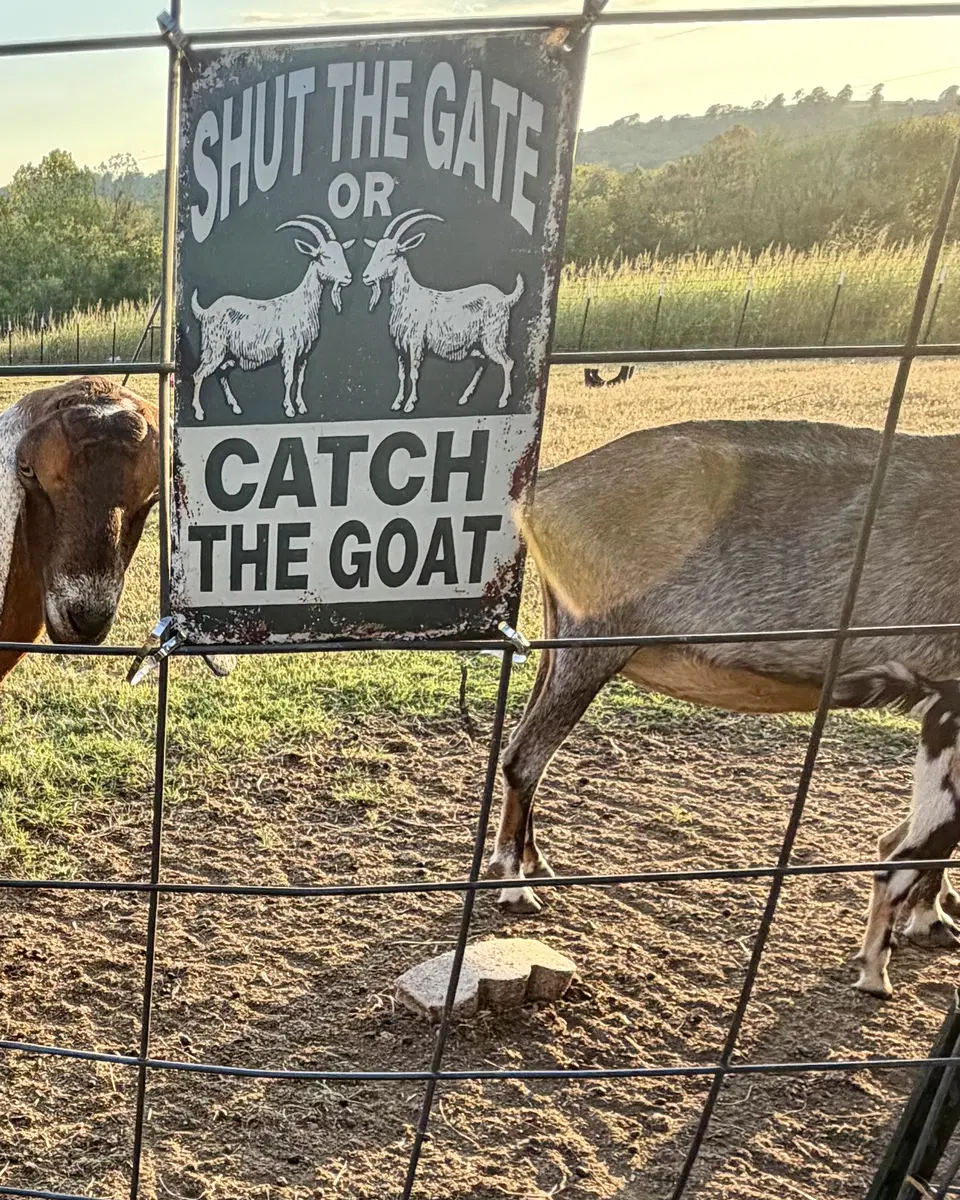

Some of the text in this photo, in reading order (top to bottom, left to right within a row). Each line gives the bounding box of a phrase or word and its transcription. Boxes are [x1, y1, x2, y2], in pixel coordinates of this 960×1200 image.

[190, 60, 544, 243] SHUT THE GATE
[328, 171, 395, 219] OR
[204, 430, 490, 511] CATCH
[188, 514, 503, 592] THE GOAT
